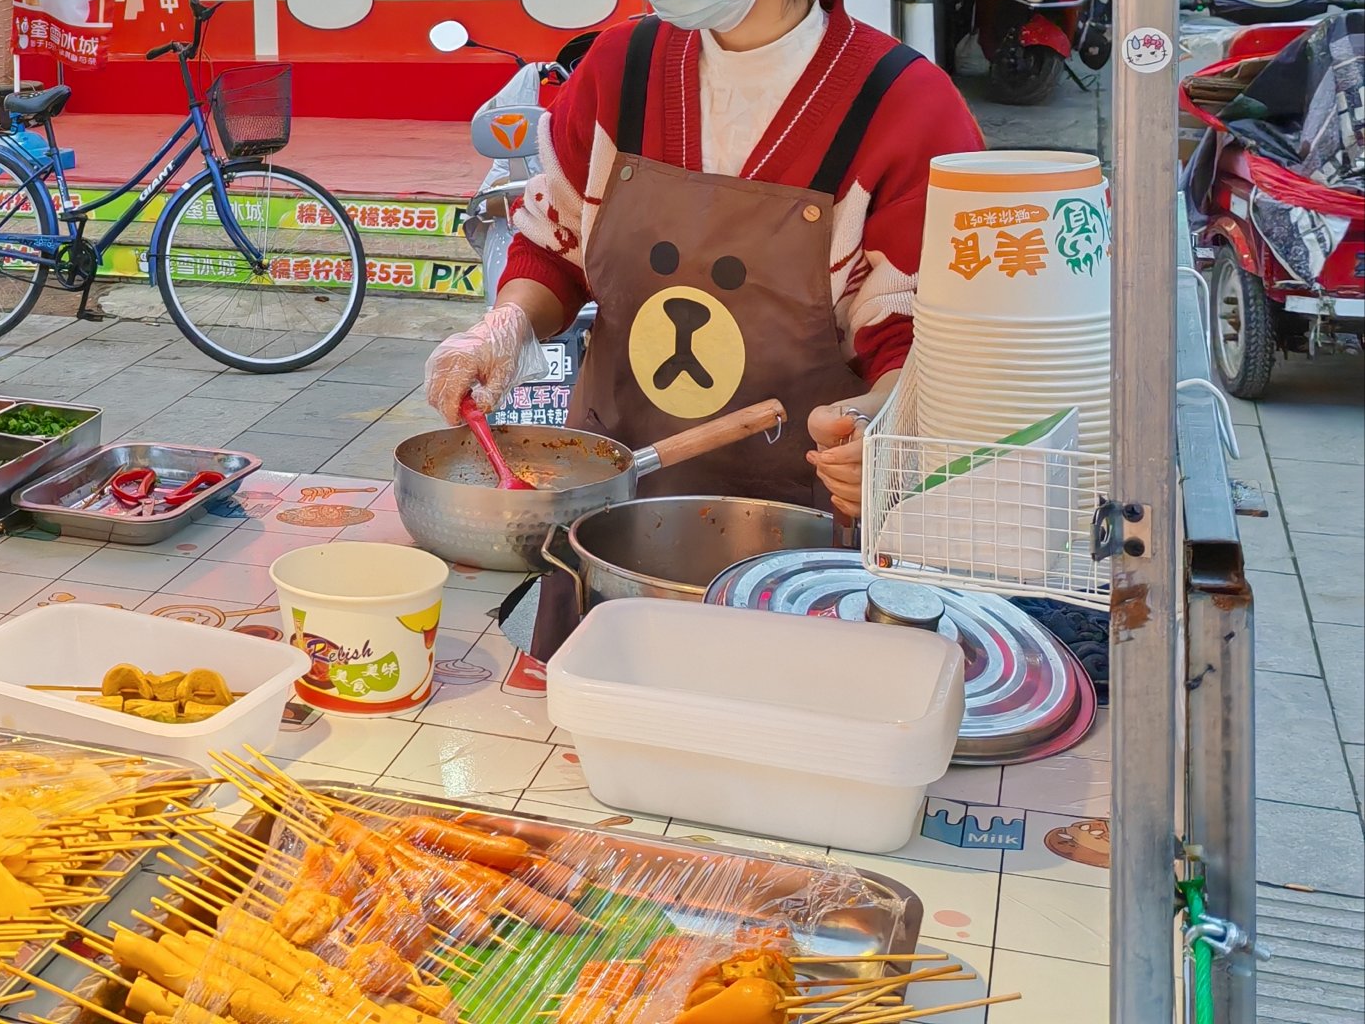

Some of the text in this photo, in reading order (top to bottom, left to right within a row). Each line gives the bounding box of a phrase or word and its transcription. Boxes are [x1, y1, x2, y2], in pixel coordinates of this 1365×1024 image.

[30, 19, 100, 57] 蜜雪冰城
[139, 160, 175, 201] GIANT
[948, 228, 1050, 280] 美食
[429, 262, 478, 292] PK
[306, 639, 374, 664] Relish
[967, 832, 1019, 845] Milk
